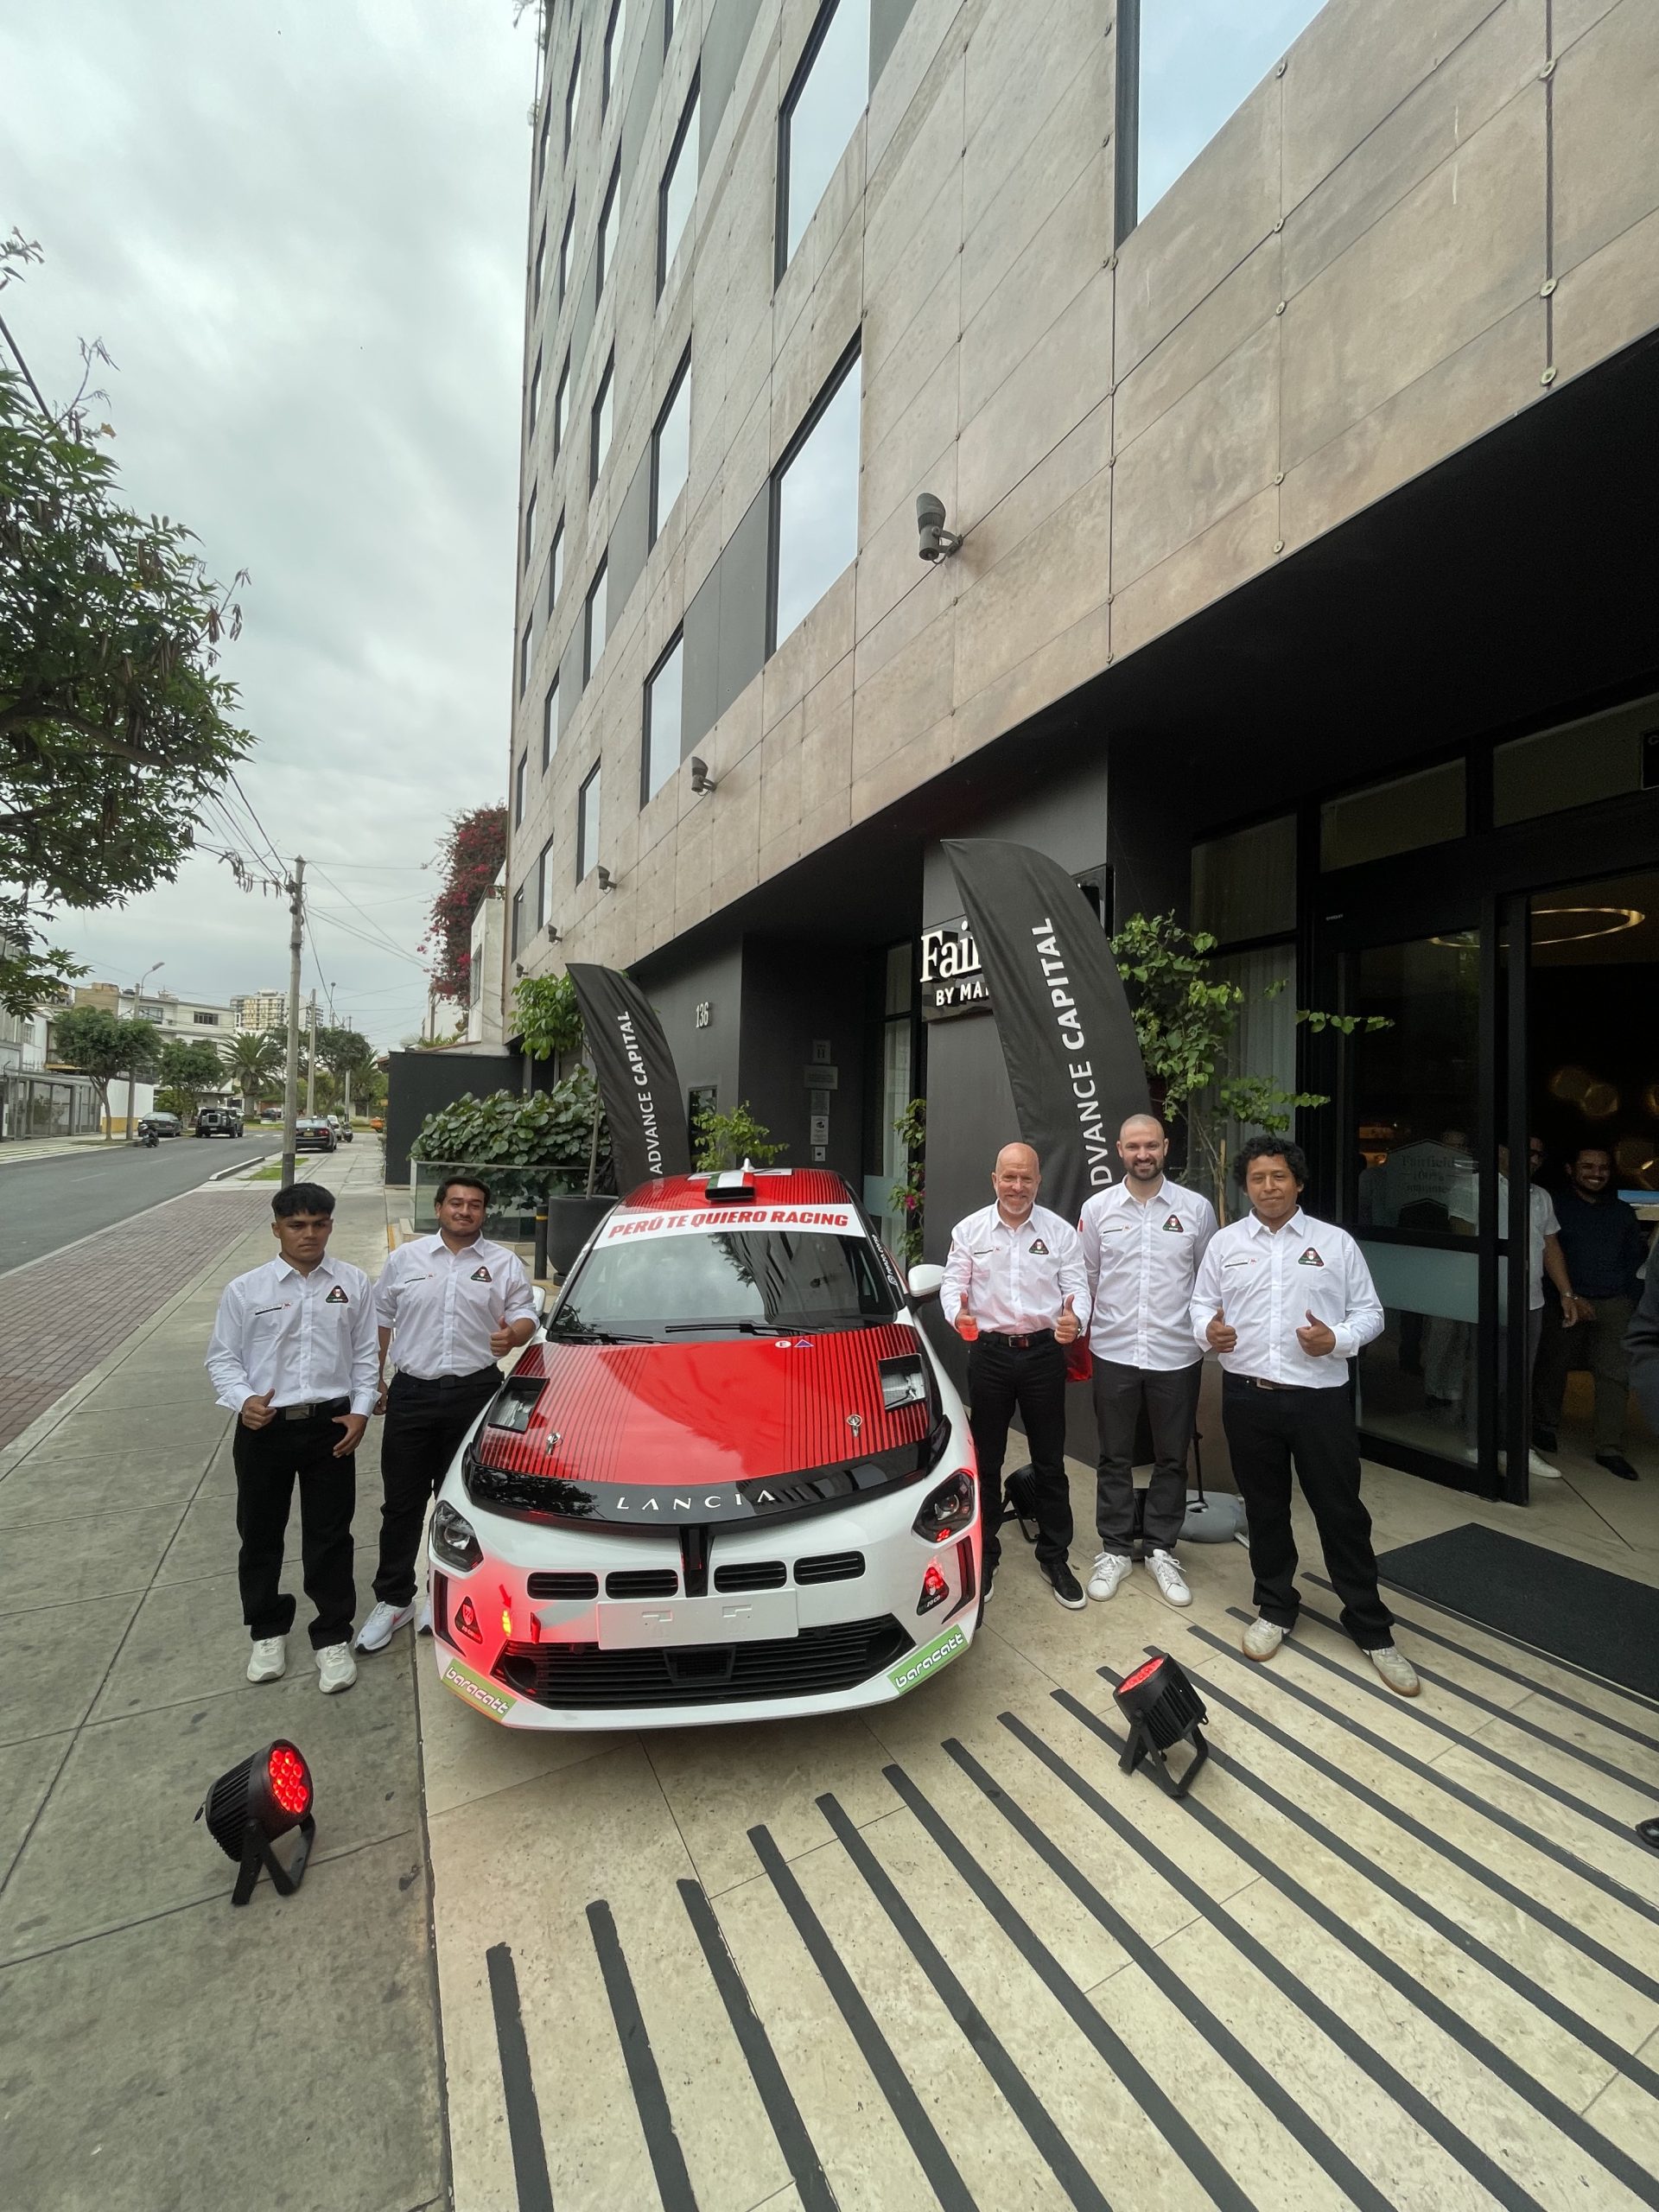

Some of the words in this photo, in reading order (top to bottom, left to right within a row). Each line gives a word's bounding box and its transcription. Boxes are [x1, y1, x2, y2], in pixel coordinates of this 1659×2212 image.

[936, 987, 955, 1007] BY
[960, 981, 989, 1001] MA
[1031, 918, 1085, 1050] CAPITAL
[696, 1001, 709, 1028] 136
[617, 1010, 648, 1086] CAPITAL
[638, 1091, 664, 1175] ADVANCE
[1068, 1061, 1113, 1186] DVANCE
[607, 1216, 664, 1238] PERÚ
[666, 1214, 688, 1229] TE
[690, 1211, 766, 1228] QUIERO
[770, 1211, 849, 1227] RACING
[616, 1490, 775, 1510] LANCIA
[895, 1633, 963, 1688] baracatt
[446, 1667, 509, 1714] baracatt
